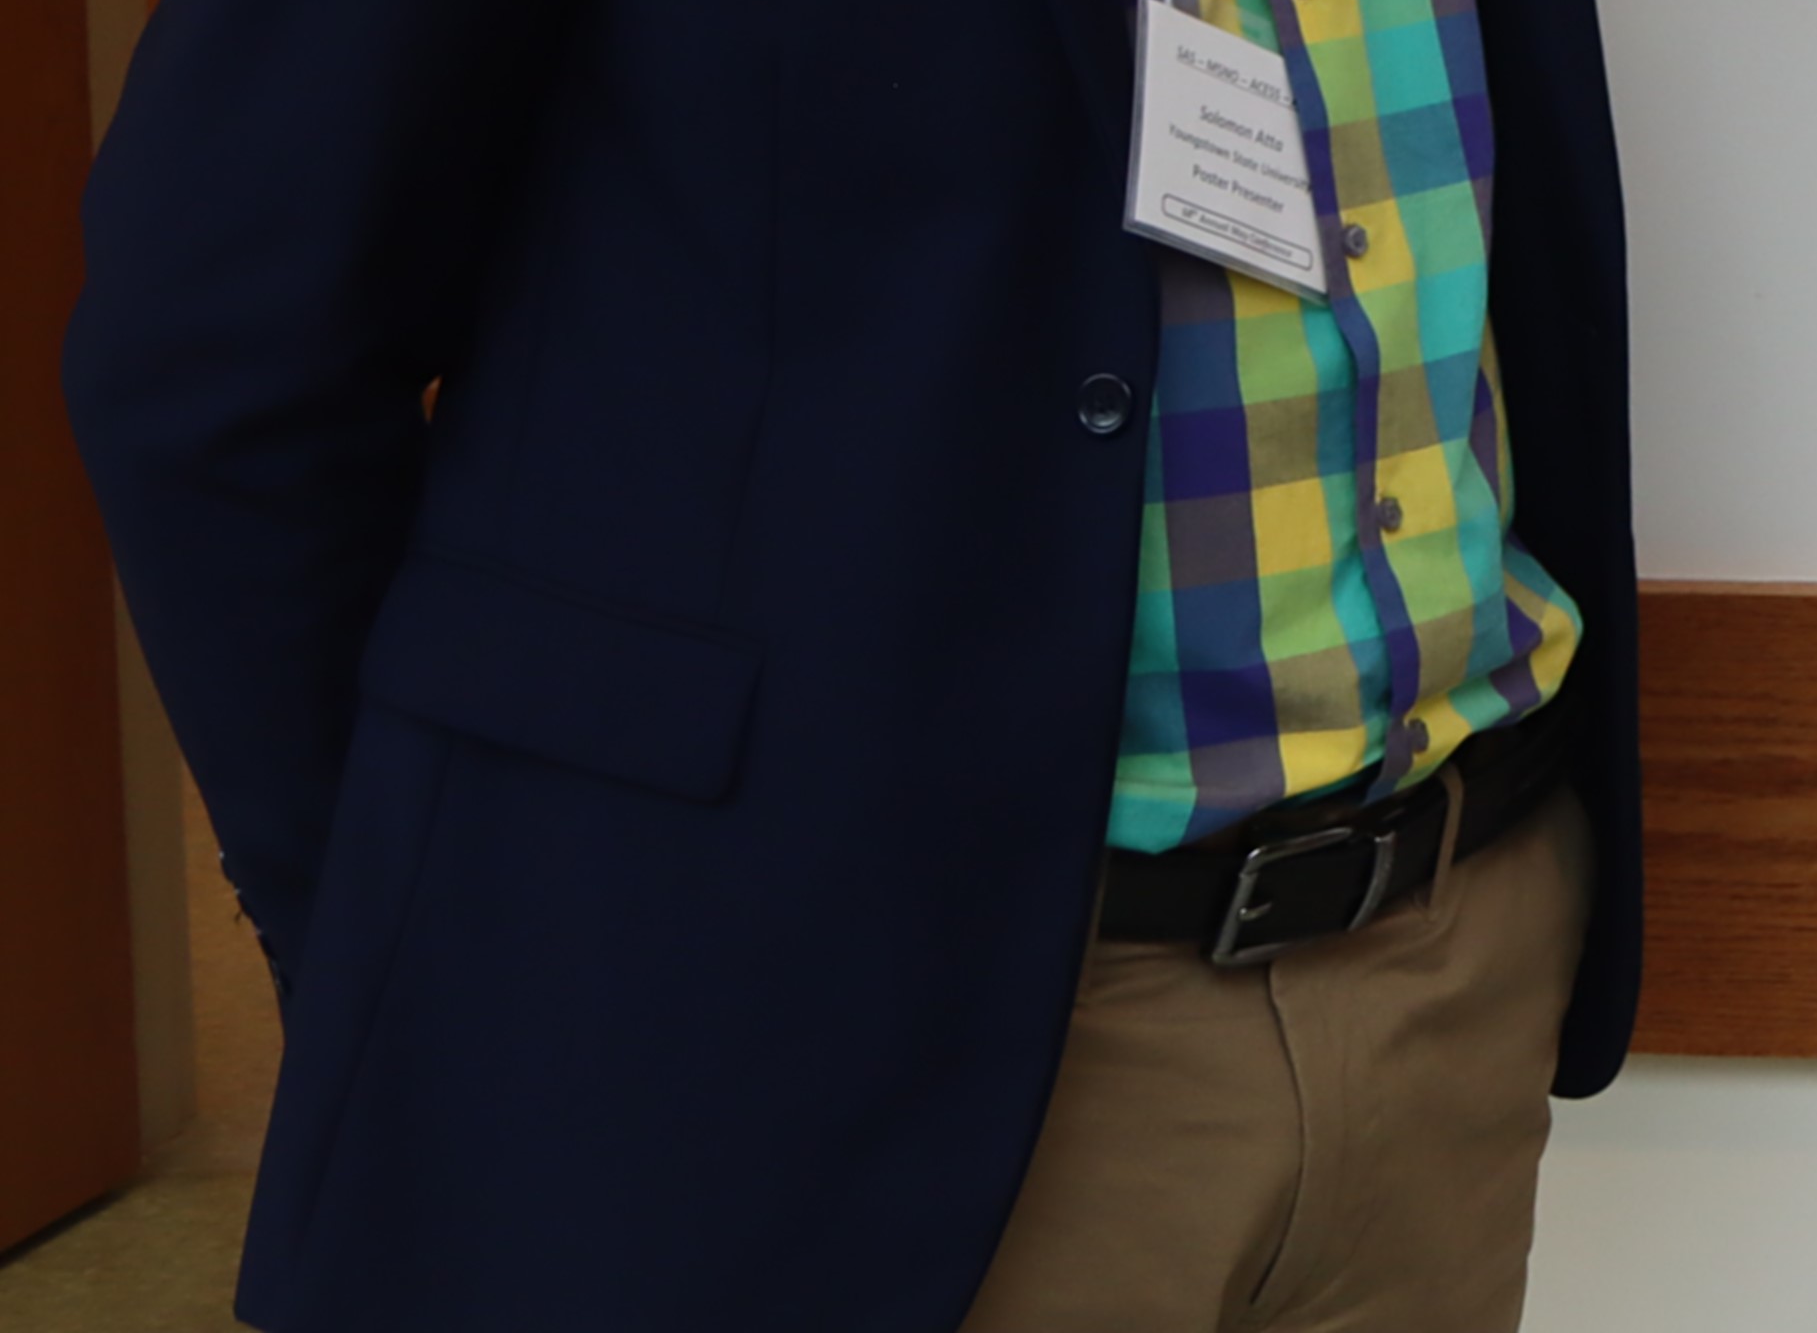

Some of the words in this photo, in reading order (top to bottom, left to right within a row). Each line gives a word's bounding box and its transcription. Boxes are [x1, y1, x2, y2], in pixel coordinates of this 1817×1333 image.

[1199, 105, 1254, 141] Solomon
[1255, 130, 1284, 153] Atta
[1168, 123, 1231, 160] Youngstown
[1233, 150, 1259, 172] State
[1260, 162, 1313, 194] University
[1192, 163, 1229, 190] Poster
[1231, 180, 1285, 213] Presenter
